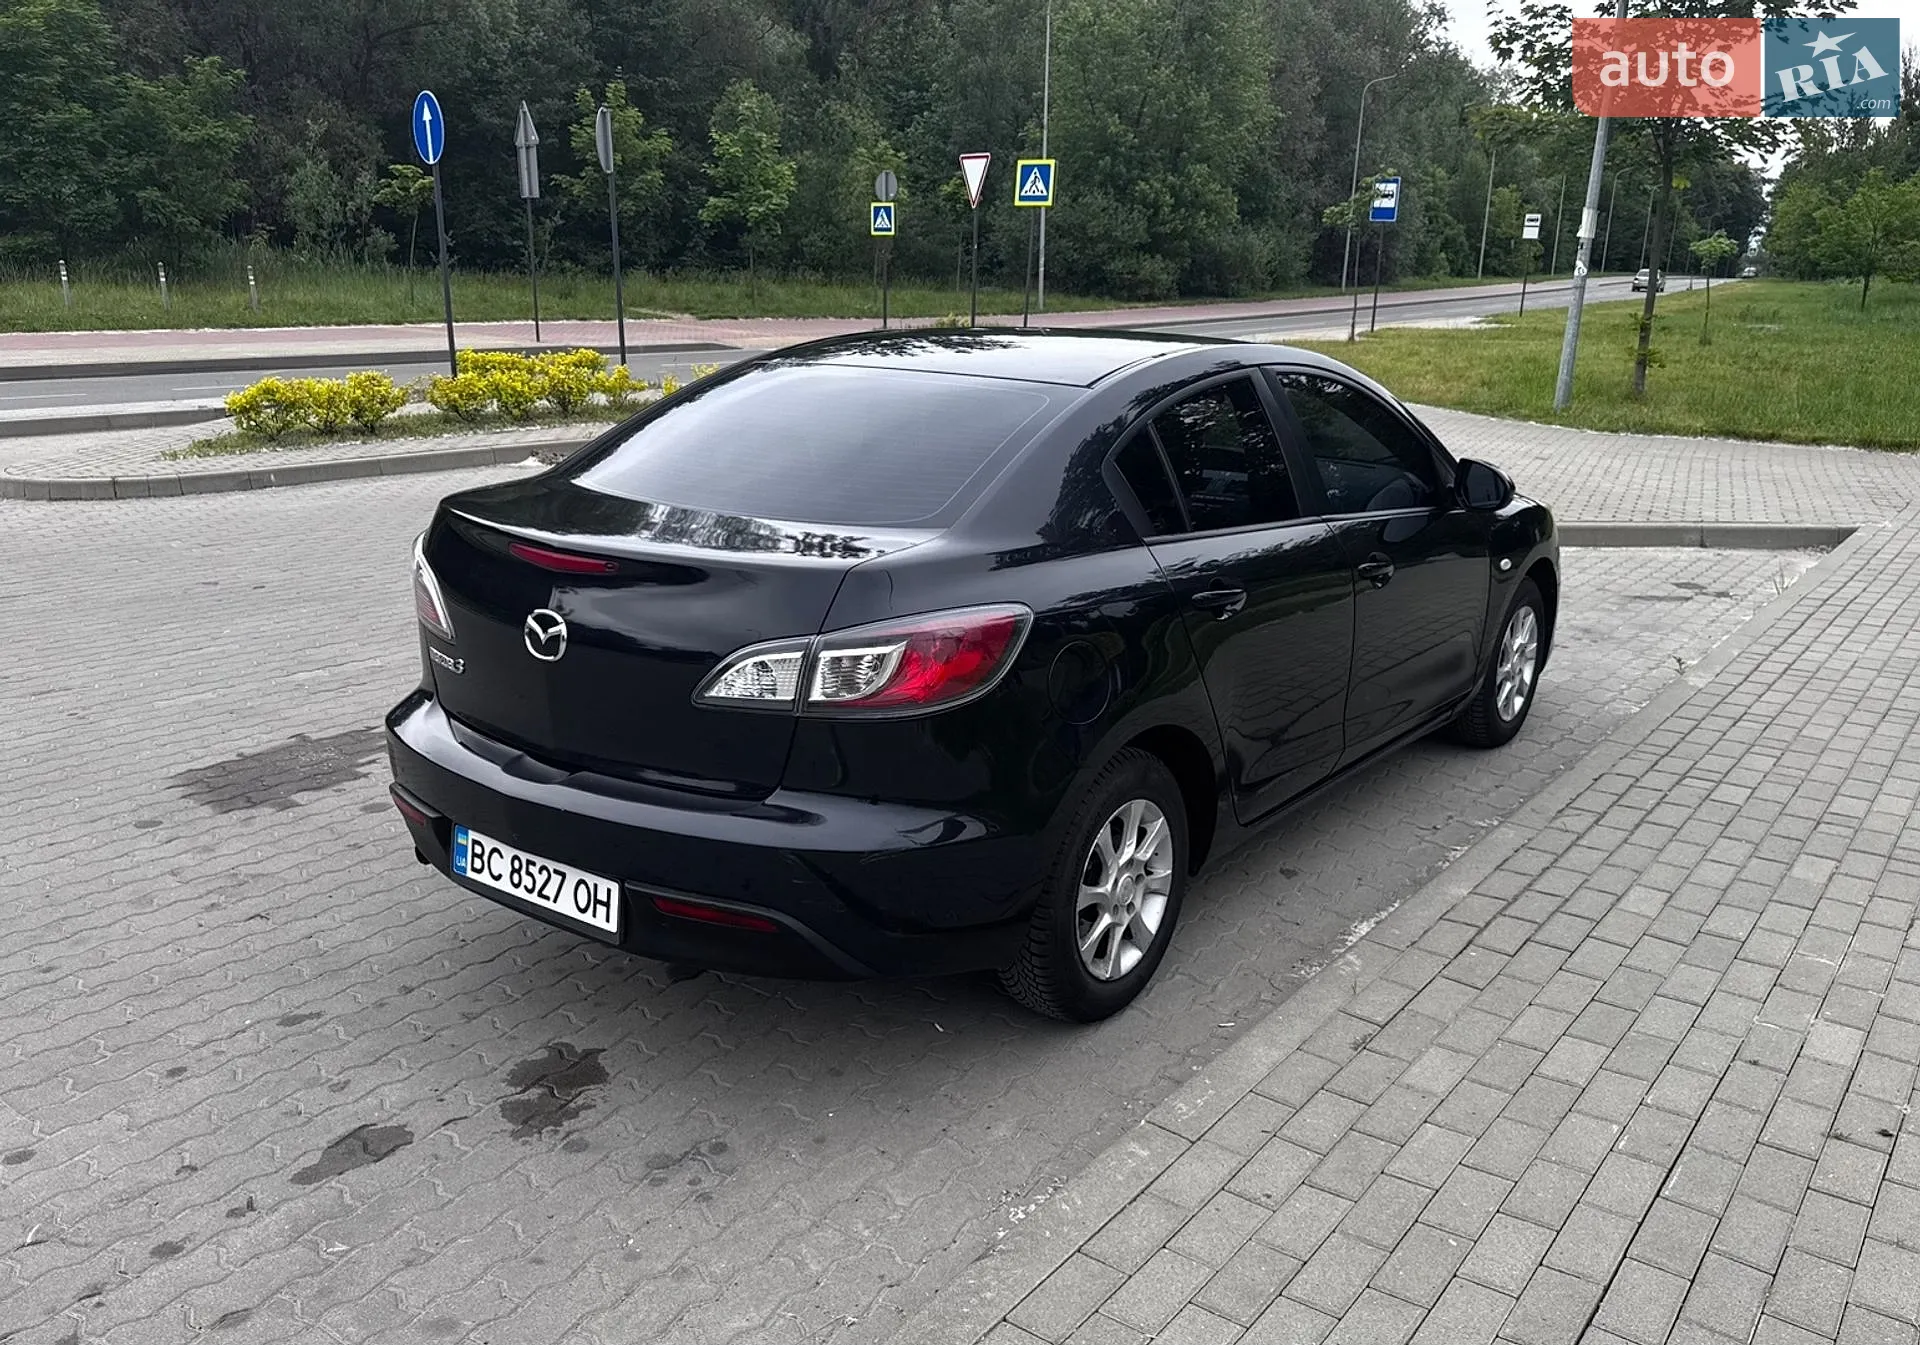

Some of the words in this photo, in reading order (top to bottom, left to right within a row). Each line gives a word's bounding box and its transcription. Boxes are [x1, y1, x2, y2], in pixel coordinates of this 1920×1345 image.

[470, 838, 504, 882] BC
[509, 854, 567, 904] 8527
[573, 878, 612, 924] OH
